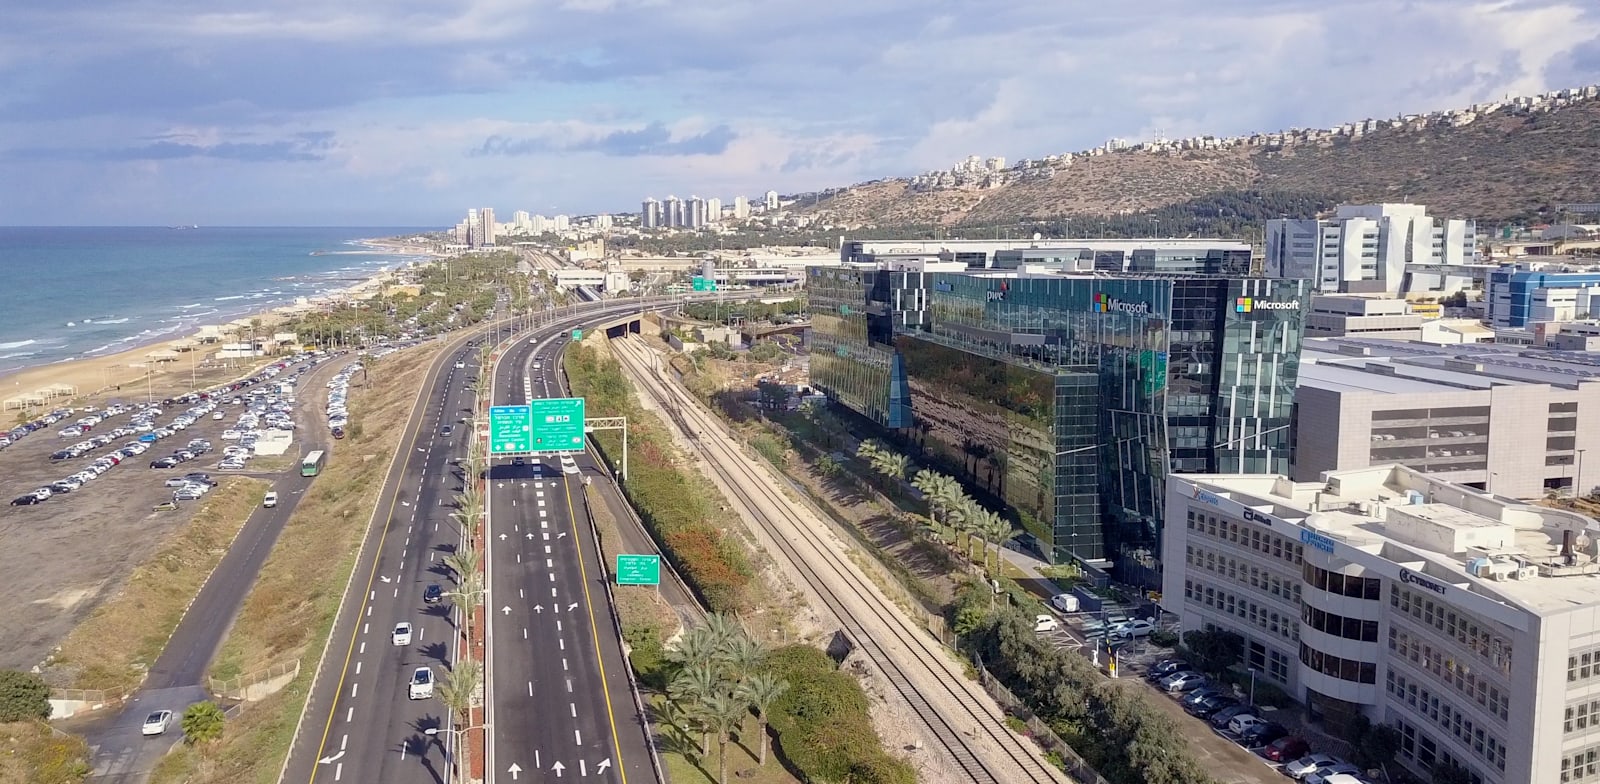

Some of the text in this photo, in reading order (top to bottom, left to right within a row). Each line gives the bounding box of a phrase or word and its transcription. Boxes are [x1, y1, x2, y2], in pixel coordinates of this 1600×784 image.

[987, 291, 1003, 302] pwc
[1108, 298, 1147, 314] Microsoft
[1254, 300, 1299, 309] Microsoft
